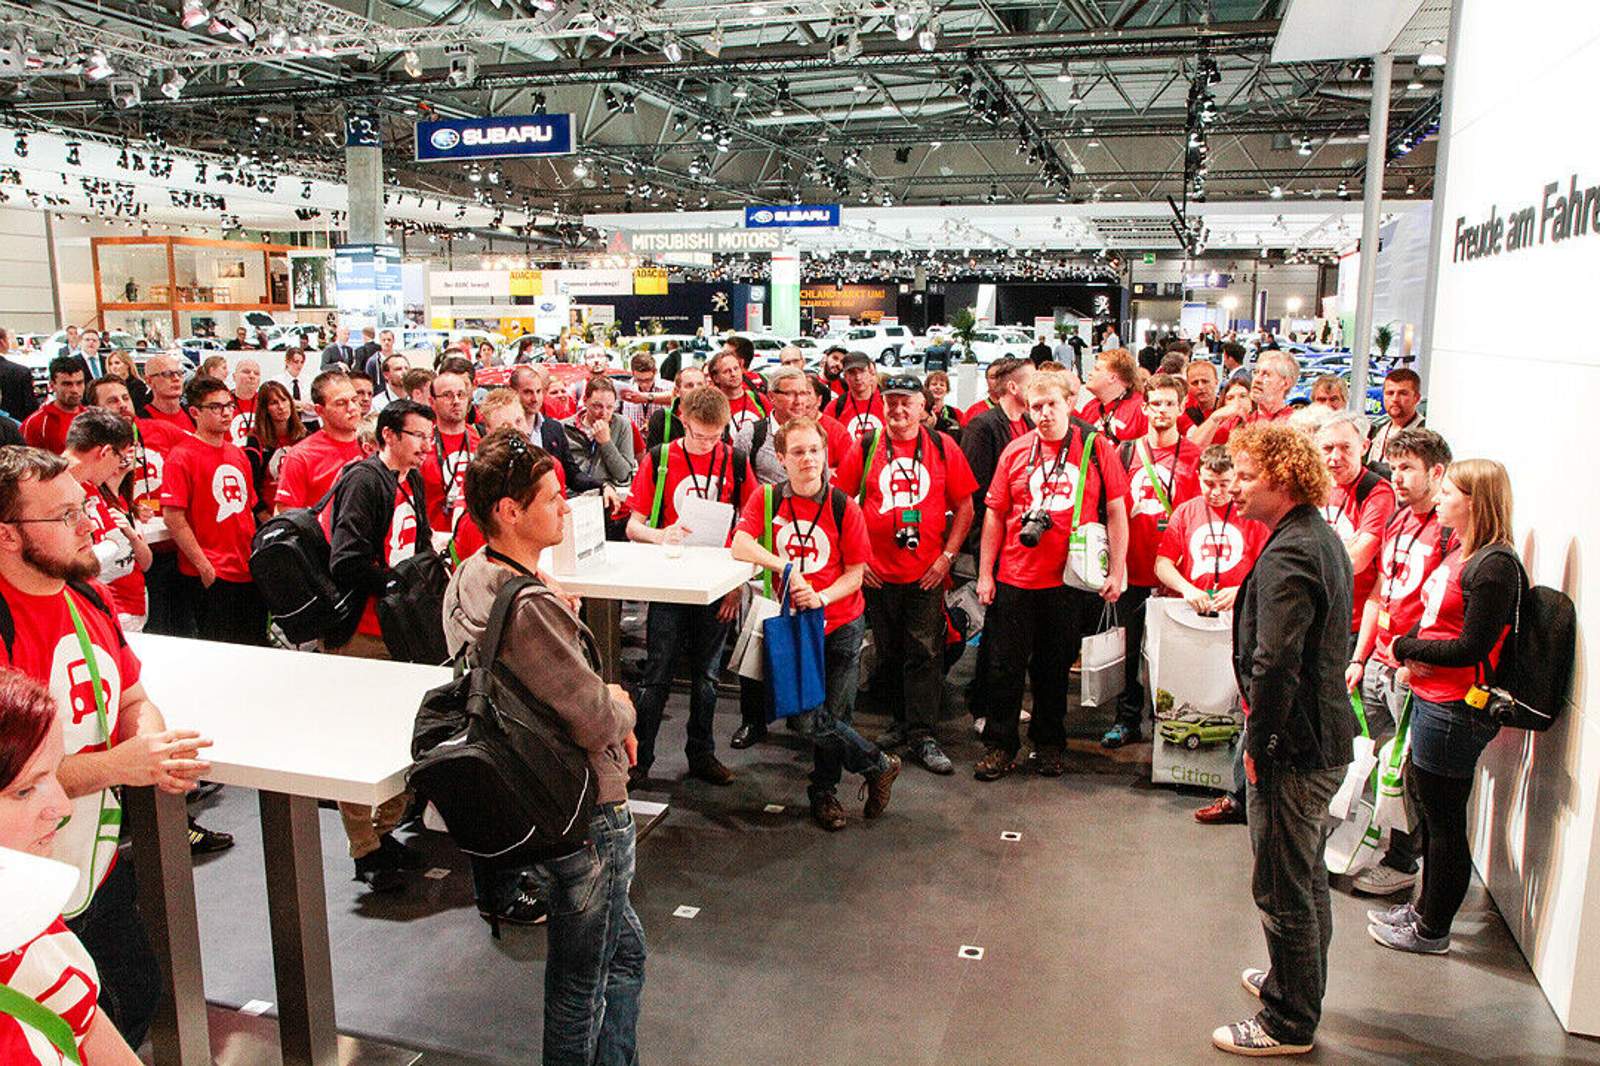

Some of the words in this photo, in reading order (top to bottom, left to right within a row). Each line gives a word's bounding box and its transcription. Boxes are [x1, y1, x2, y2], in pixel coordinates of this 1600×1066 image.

[461, 125, 553, 146] SUBARU
[774, 210, 830, 221] SUBARU
[632, 231, 714, 250] MITSUBISHI
[717, 230, 780, 249] MOTORS
[1453, 204, 1504, 263] Freude
[1506, 206, 1535, 252] am
[636, 269, 657, 278] ADAC
[1171, 765, 1222, 785] Citigo
